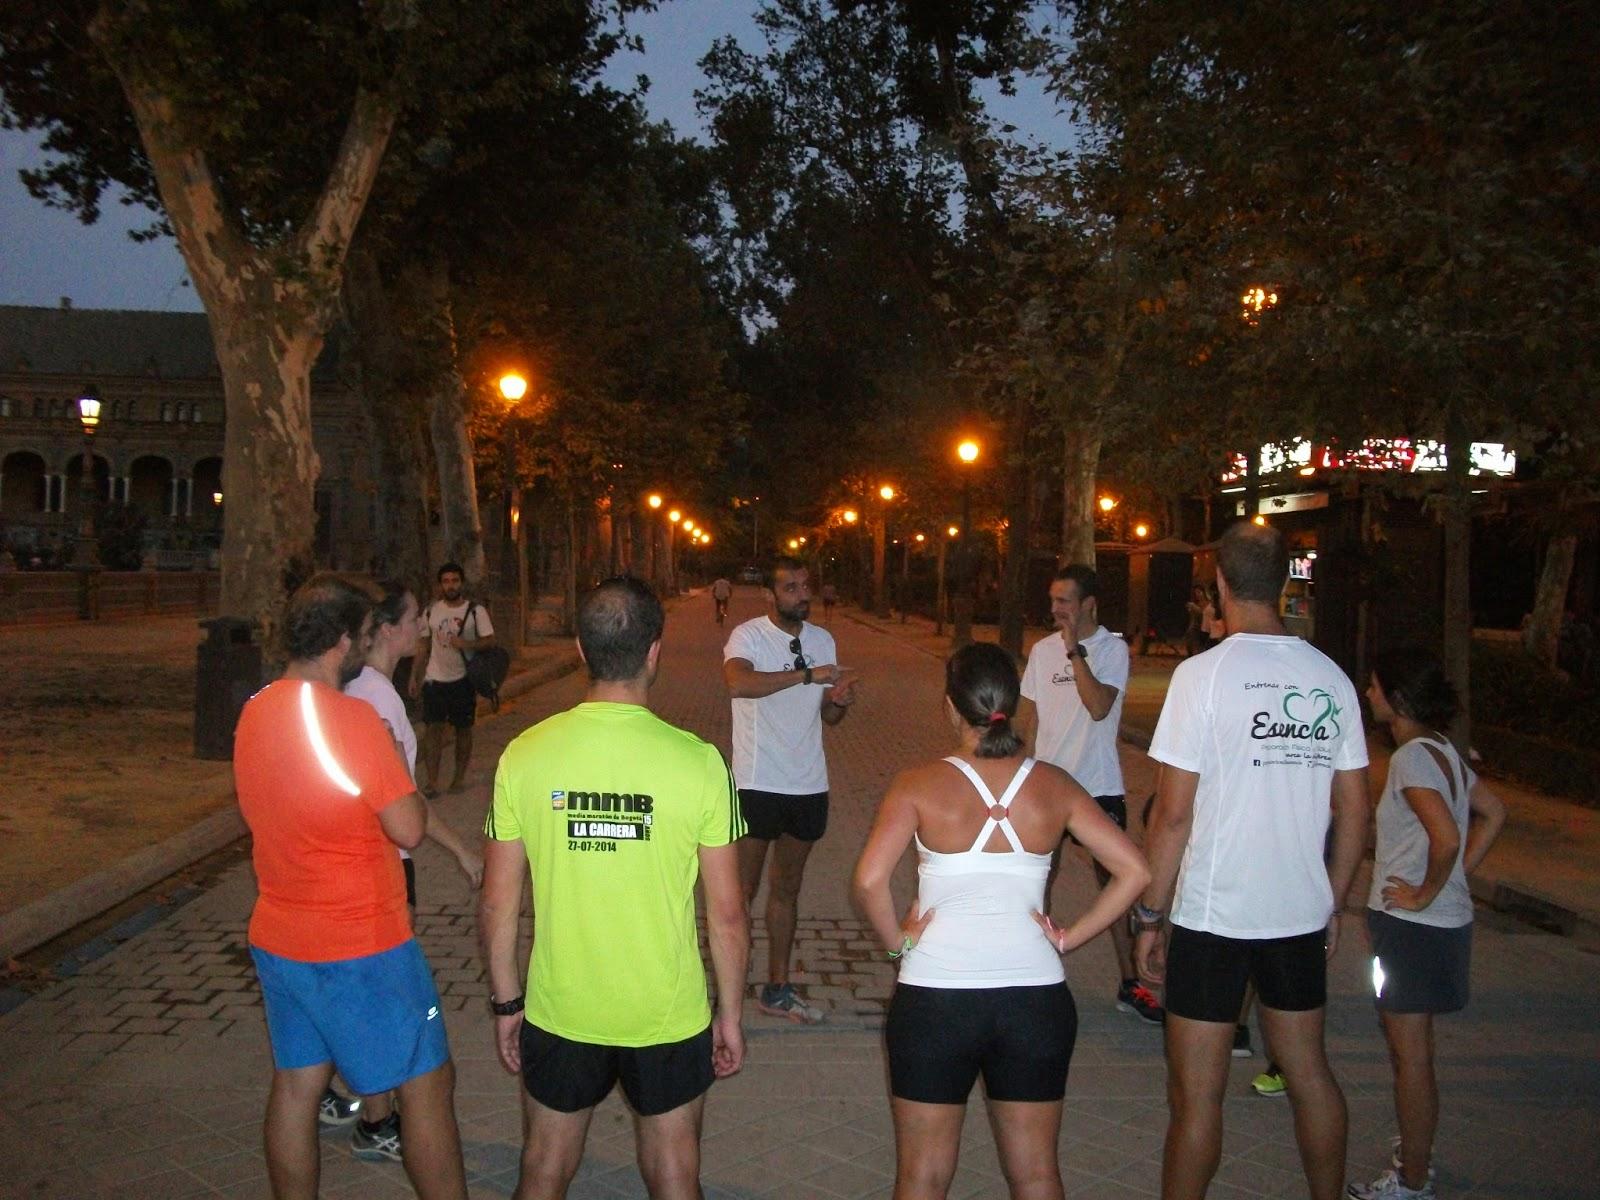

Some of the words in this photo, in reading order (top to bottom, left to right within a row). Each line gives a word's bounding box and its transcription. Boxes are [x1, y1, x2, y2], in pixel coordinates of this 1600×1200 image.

[1251, 712, 1329, 740] Esencia
[568, 791, 653, 813] mmB
[644, 816, 651, 825] 15
[574, 823, 587, 836] LA
[589, 823, 637, 838] CARRERA
[568, 841, 616, 851] 27-07-2014
